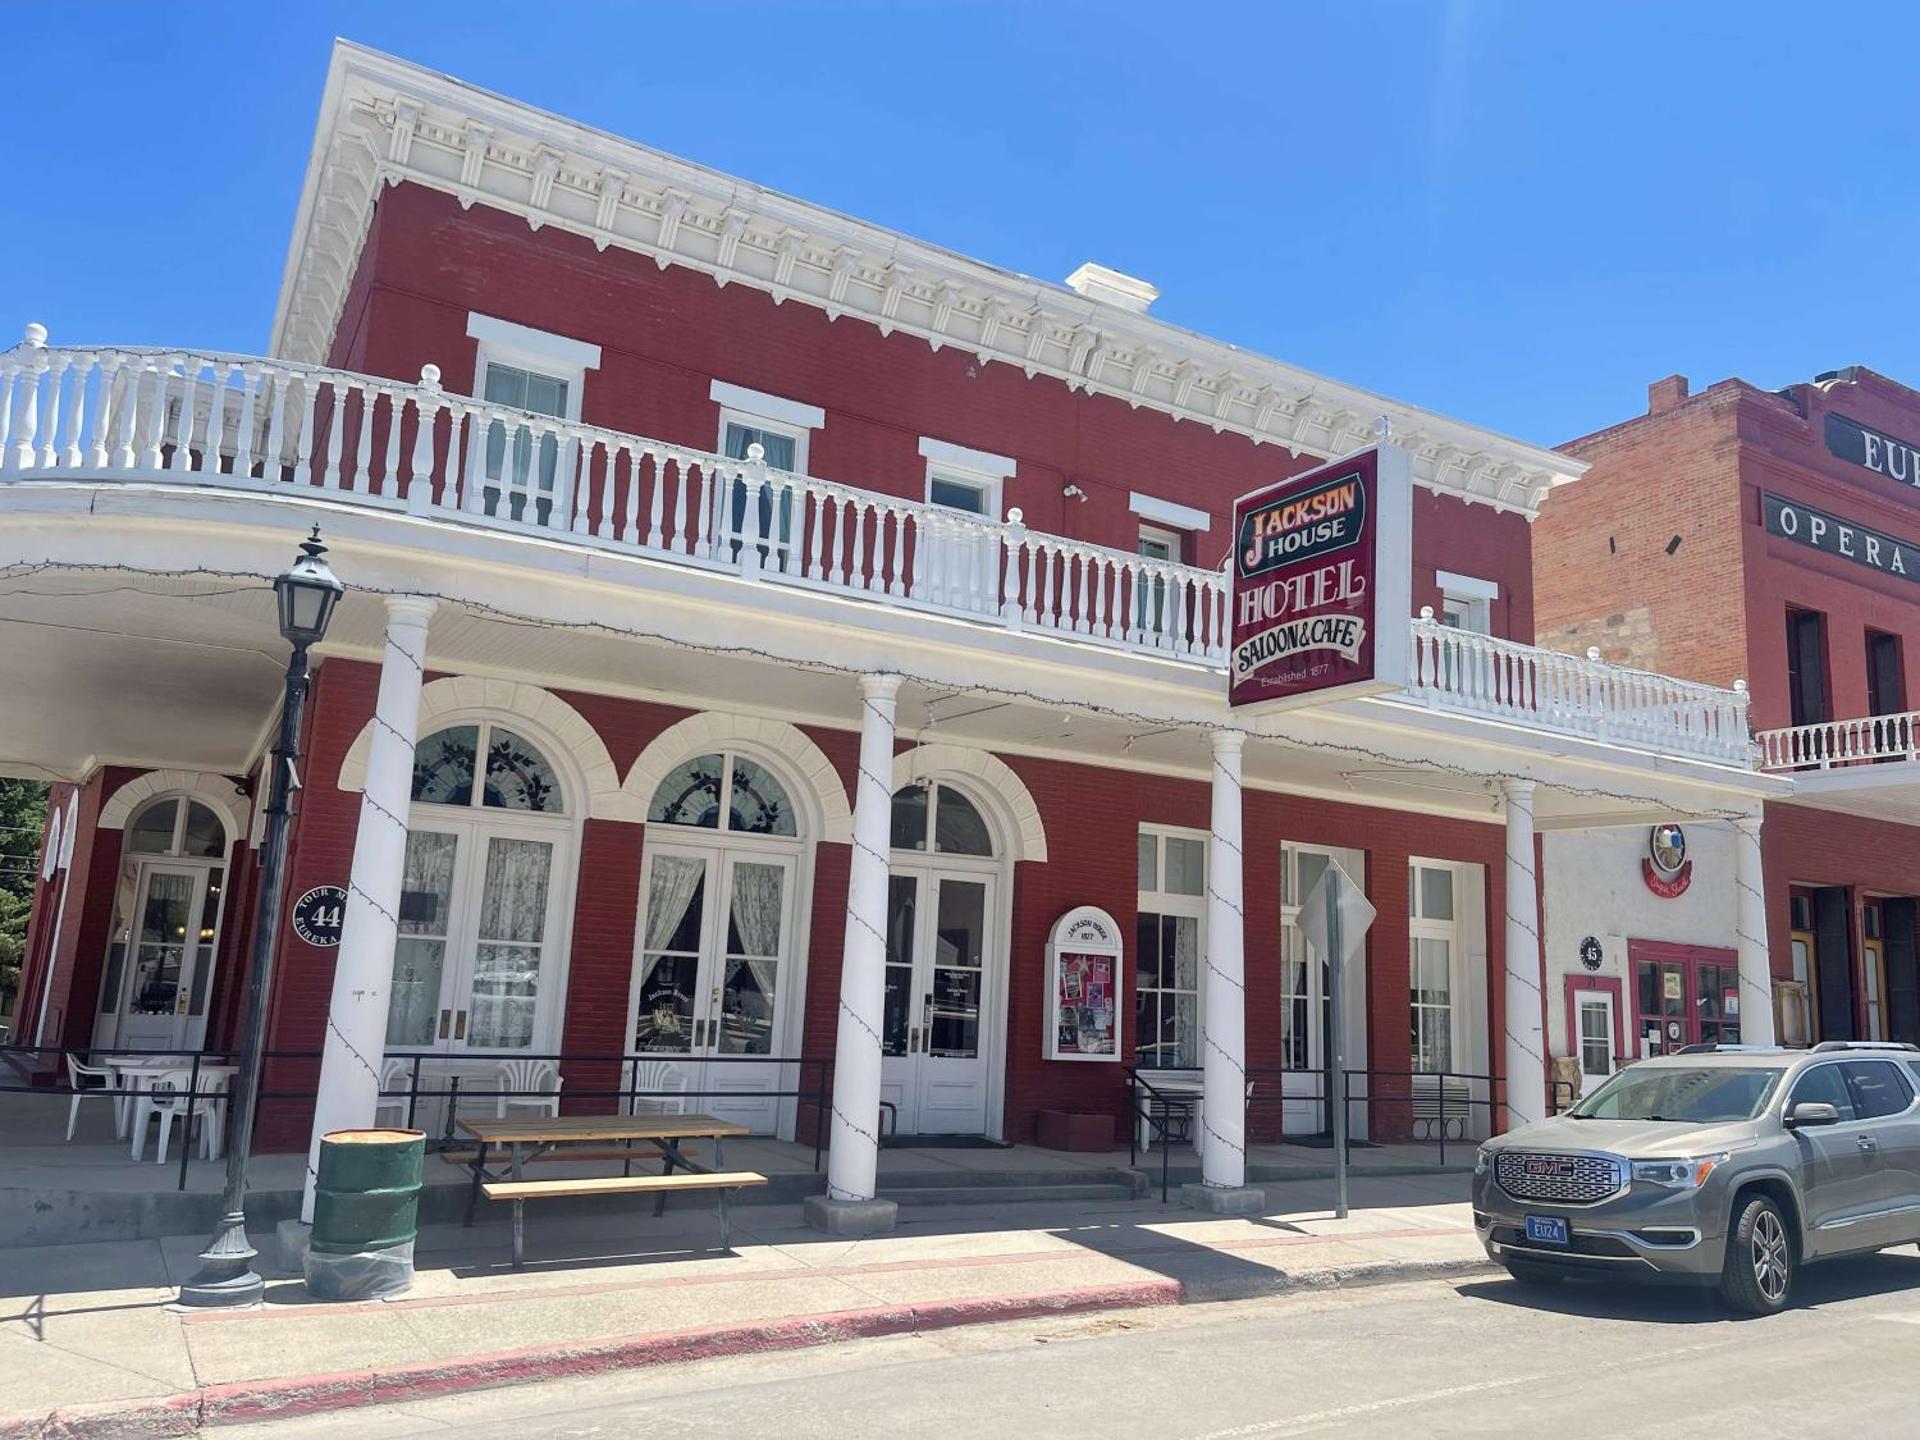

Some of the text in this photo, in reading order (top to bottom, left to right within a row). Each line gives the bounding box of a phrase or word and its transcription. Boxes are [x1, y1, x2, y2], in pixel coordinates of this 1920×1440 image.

[1246, 483, 1355, 567] JACKSON
[1268, 517, 1346, 559] HOUSE
[1780, 507, 1906, 574] OPERA
[1238, 559, 1366, 628] HOTEL
[1261, 663, 1330, 687] Established 1877
[299, 888, 329, 909] TOUR
[310, 905, 341, 928] 44
[296, 917, 337, 944] EUREKA
[1586, 946, 1598, 961] 45
[1526, 1161, 1572, 1176] GMC
